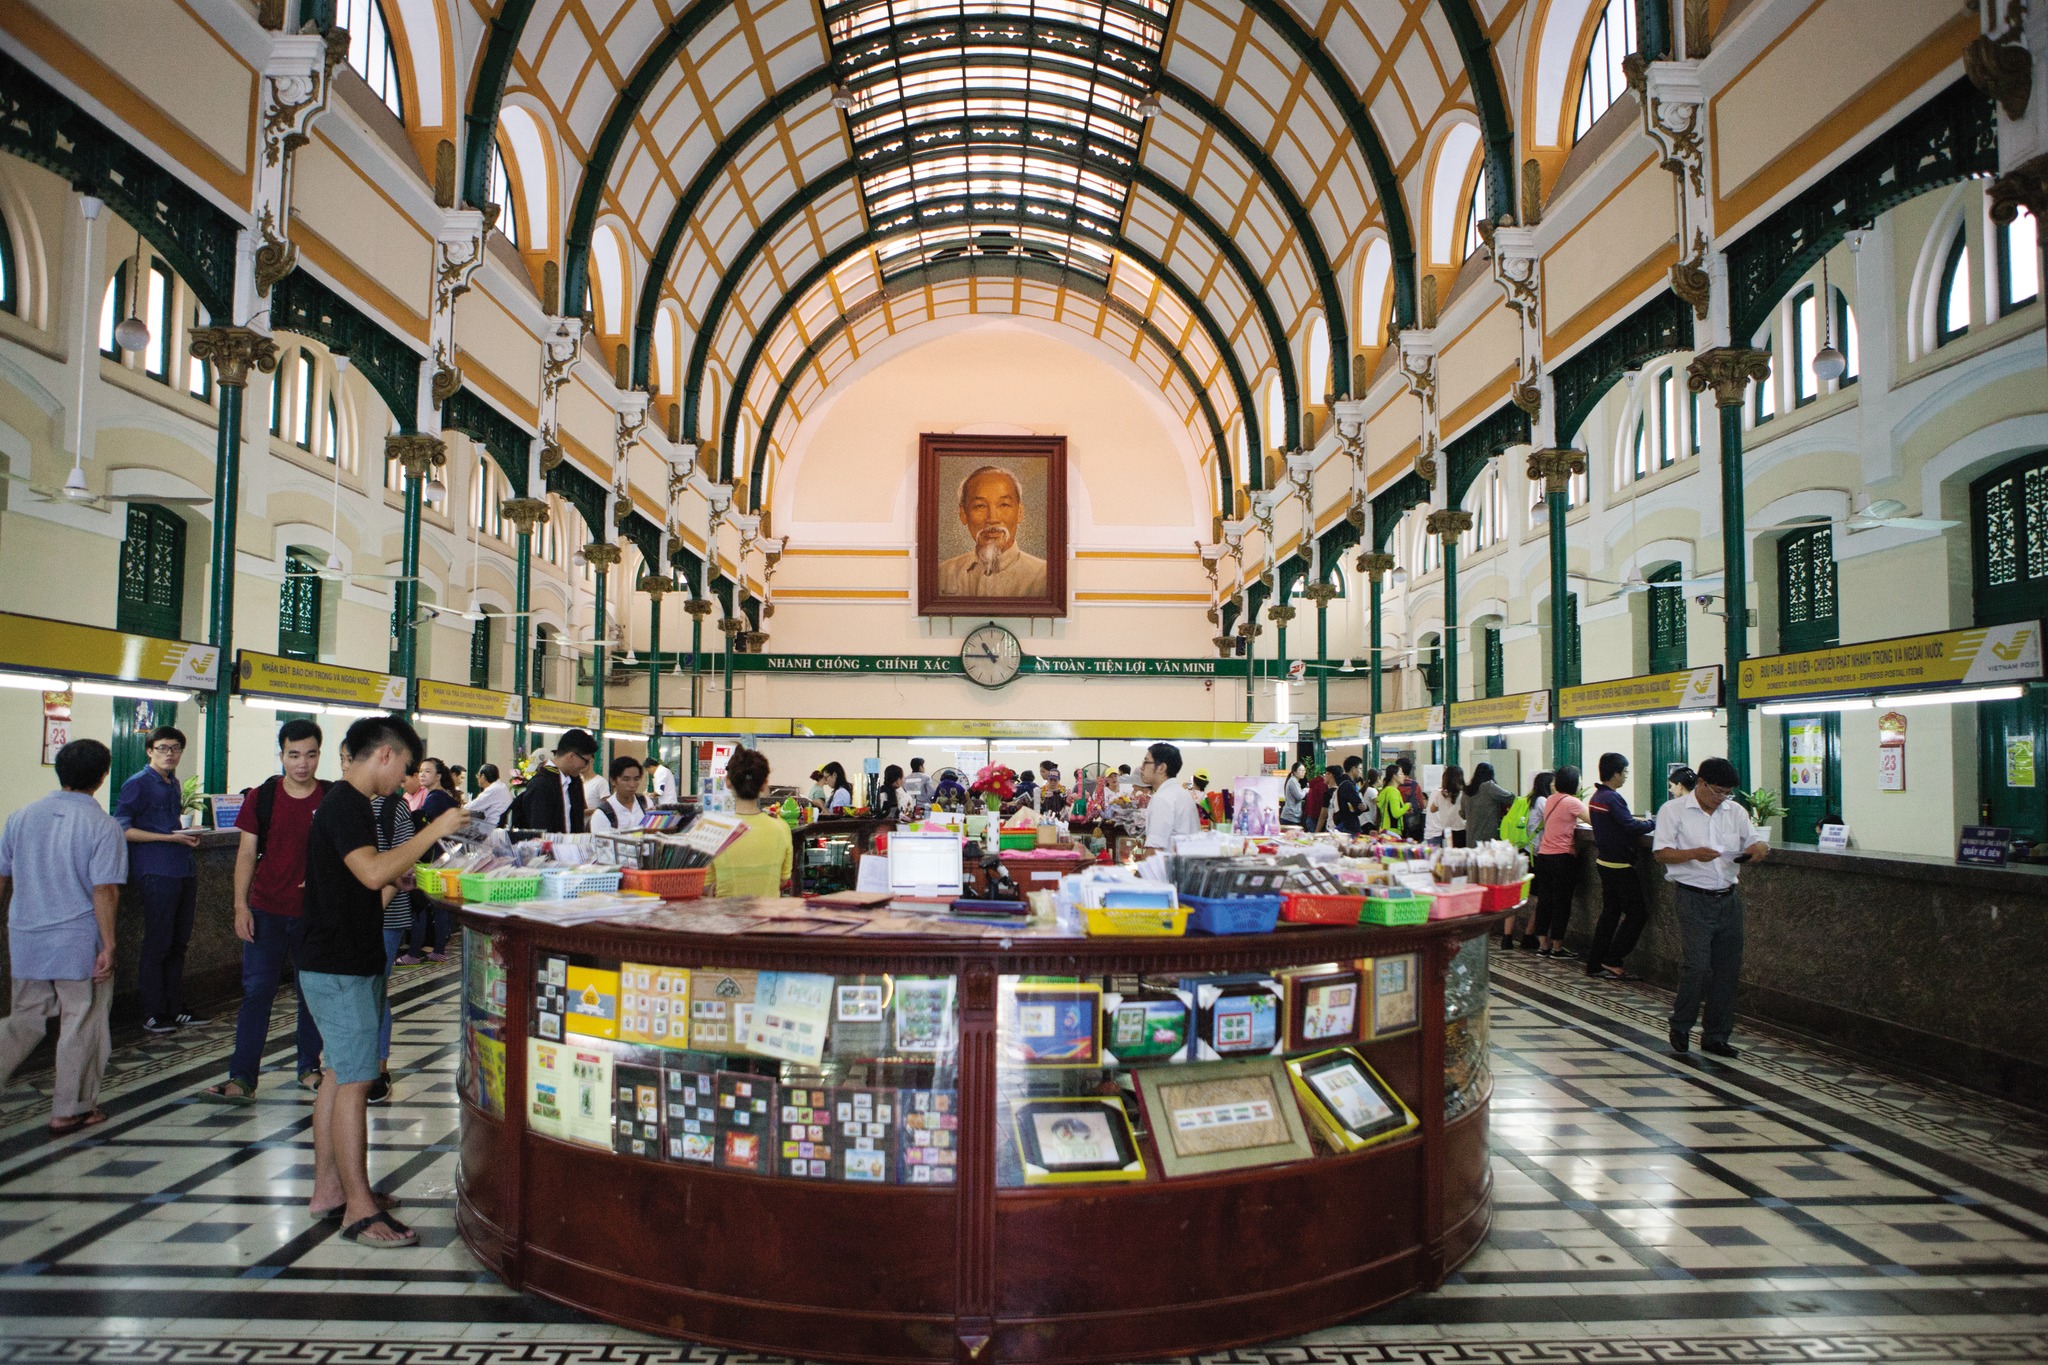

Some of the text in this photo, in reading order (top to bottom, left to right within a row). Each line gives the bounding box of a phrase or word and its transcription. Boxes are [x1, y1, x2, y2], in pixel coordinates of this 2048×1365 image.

[768, 658, 811, 668] NHANH
[816, 656, 860, 669] CHÓNG
[876, 658, 918, 669] CHÍNH
[924, 657, 950, 670] XÁC
[1034, 660, 1050, 670] AN
[1053, 659, 1085, 671] TOÀN
[1094, 659, 1123, 673] TIỆN
[1126, 662, 1145, 674] LỢI
[1155, 660, 1180, 671] VĂN
[1183, 662, 1215, 672] MINH
[1988, 664, 2018, 672] VIETNAM
[1767, 681, 1788, 690] DOMESTIC
[1860, 671, 1884, 680] EXPRESS
[1884, 669, 1905, 678] POSTAL
[1906, 667, 1924, 676] ITEMS
[53, 728, 66, 744] 23
[1884, 755, 1896, 770] 23
